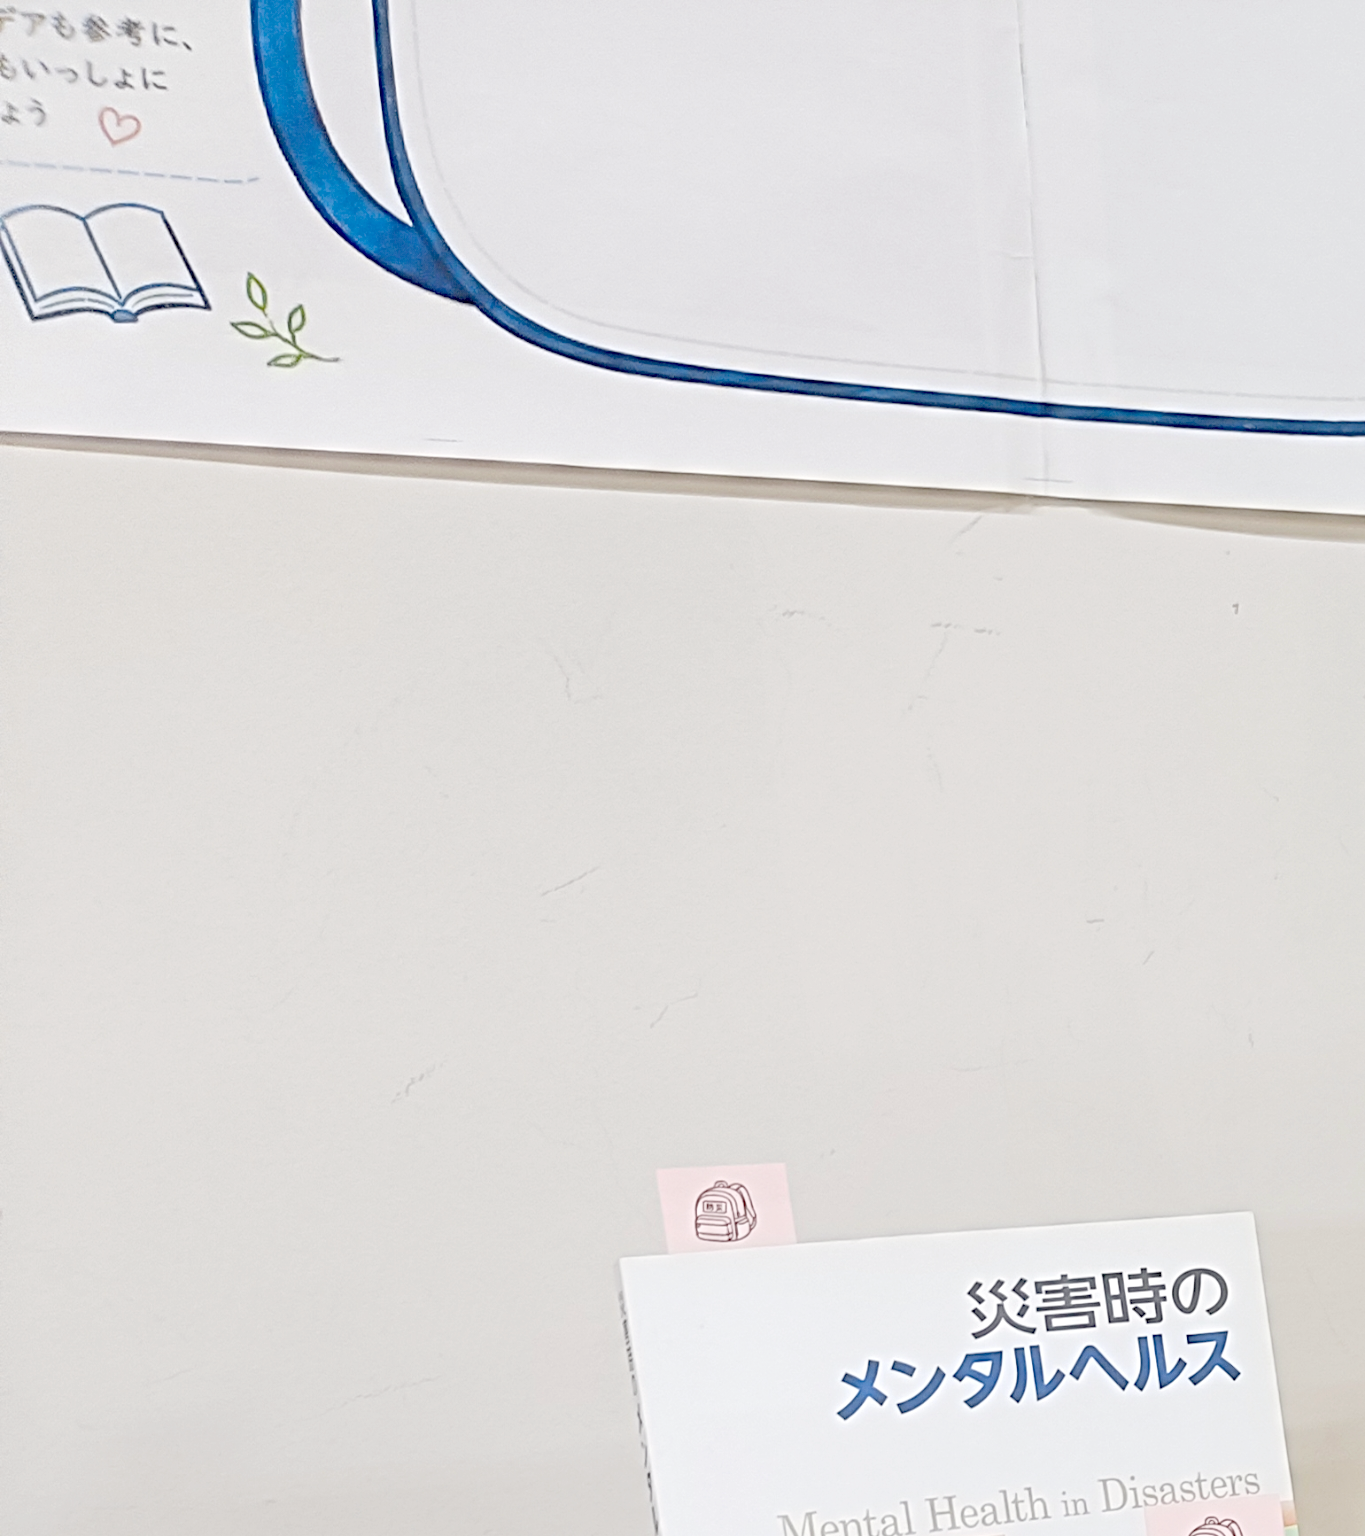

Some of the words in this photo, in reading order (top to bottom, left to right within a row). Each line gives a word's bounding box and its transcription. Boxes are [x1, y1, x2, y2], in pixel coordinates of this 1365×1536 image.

[966, 1266, 1230, 1340] 災害時の
[835, 1330, 1241, 1421] メンタルヘルス
[925, 1485, 1052, 1535] Health
[1062, 1489, 1090, 1518] in
[1099, 1468, 1261, 1514] Disasters
